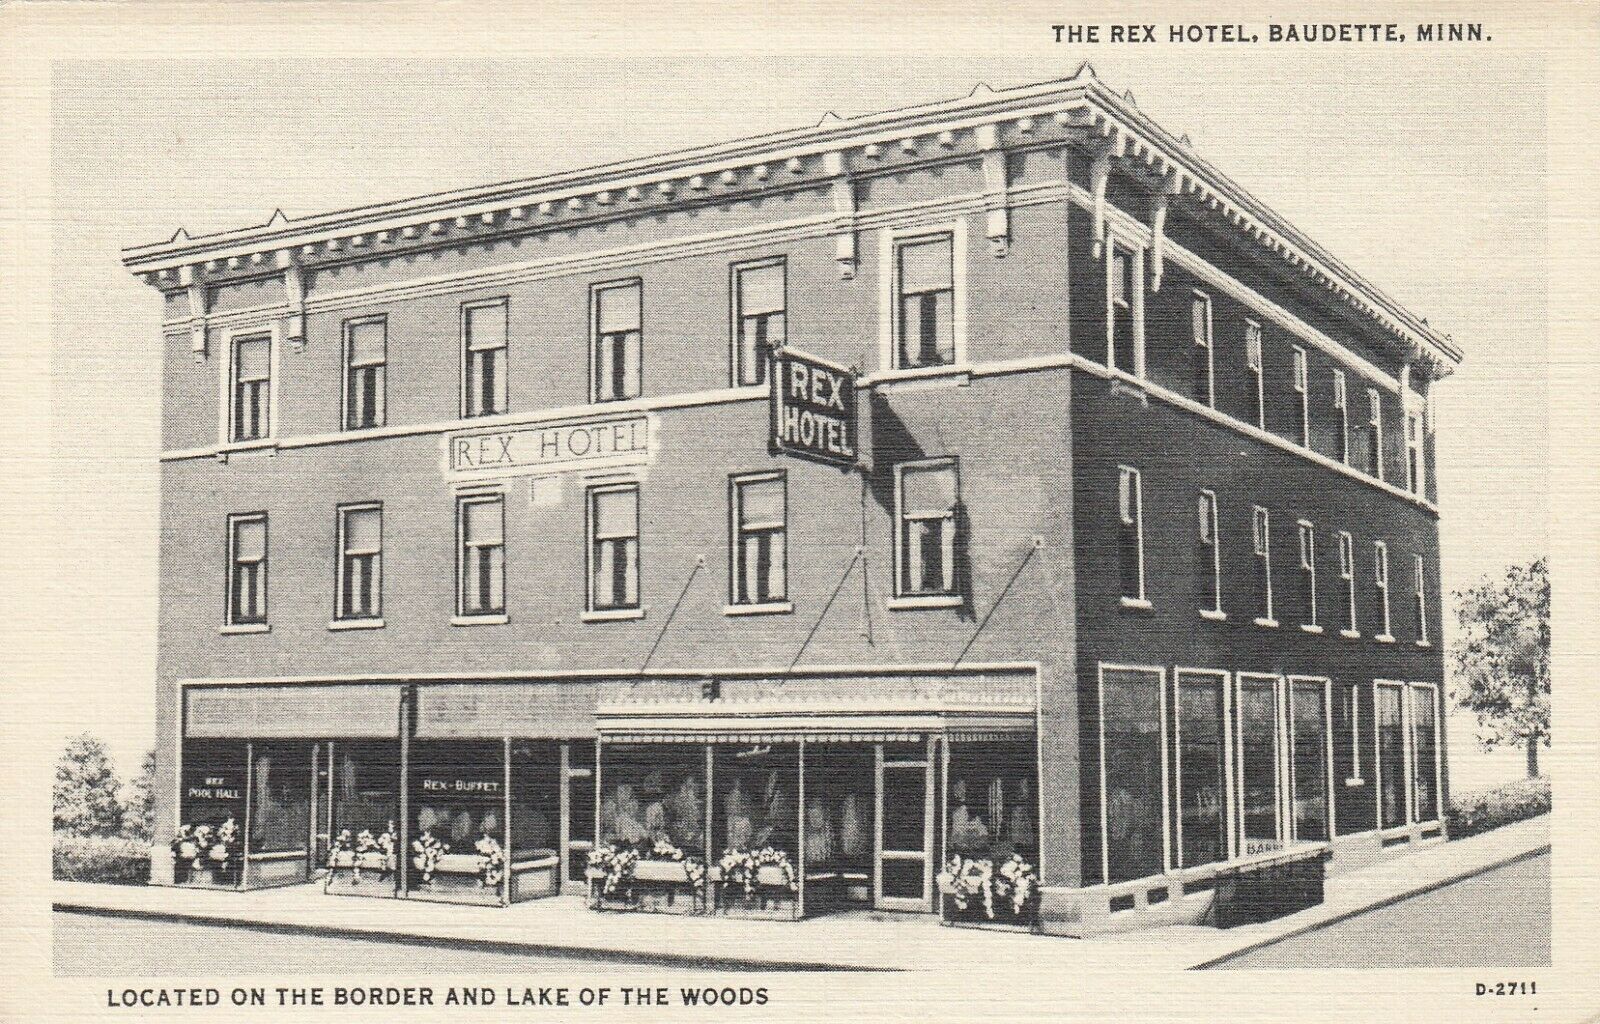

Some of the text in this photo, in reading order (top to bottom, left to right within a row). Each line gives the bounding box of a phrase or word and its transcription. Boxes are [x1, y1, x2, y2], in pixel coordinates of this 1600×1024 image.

[791, 361, 844, 411] REX
[458, 423, 647, 466] REX HOTEL
[784, 405, 853, 456] HOTEL
[216, 788, 240, 799] HALL
